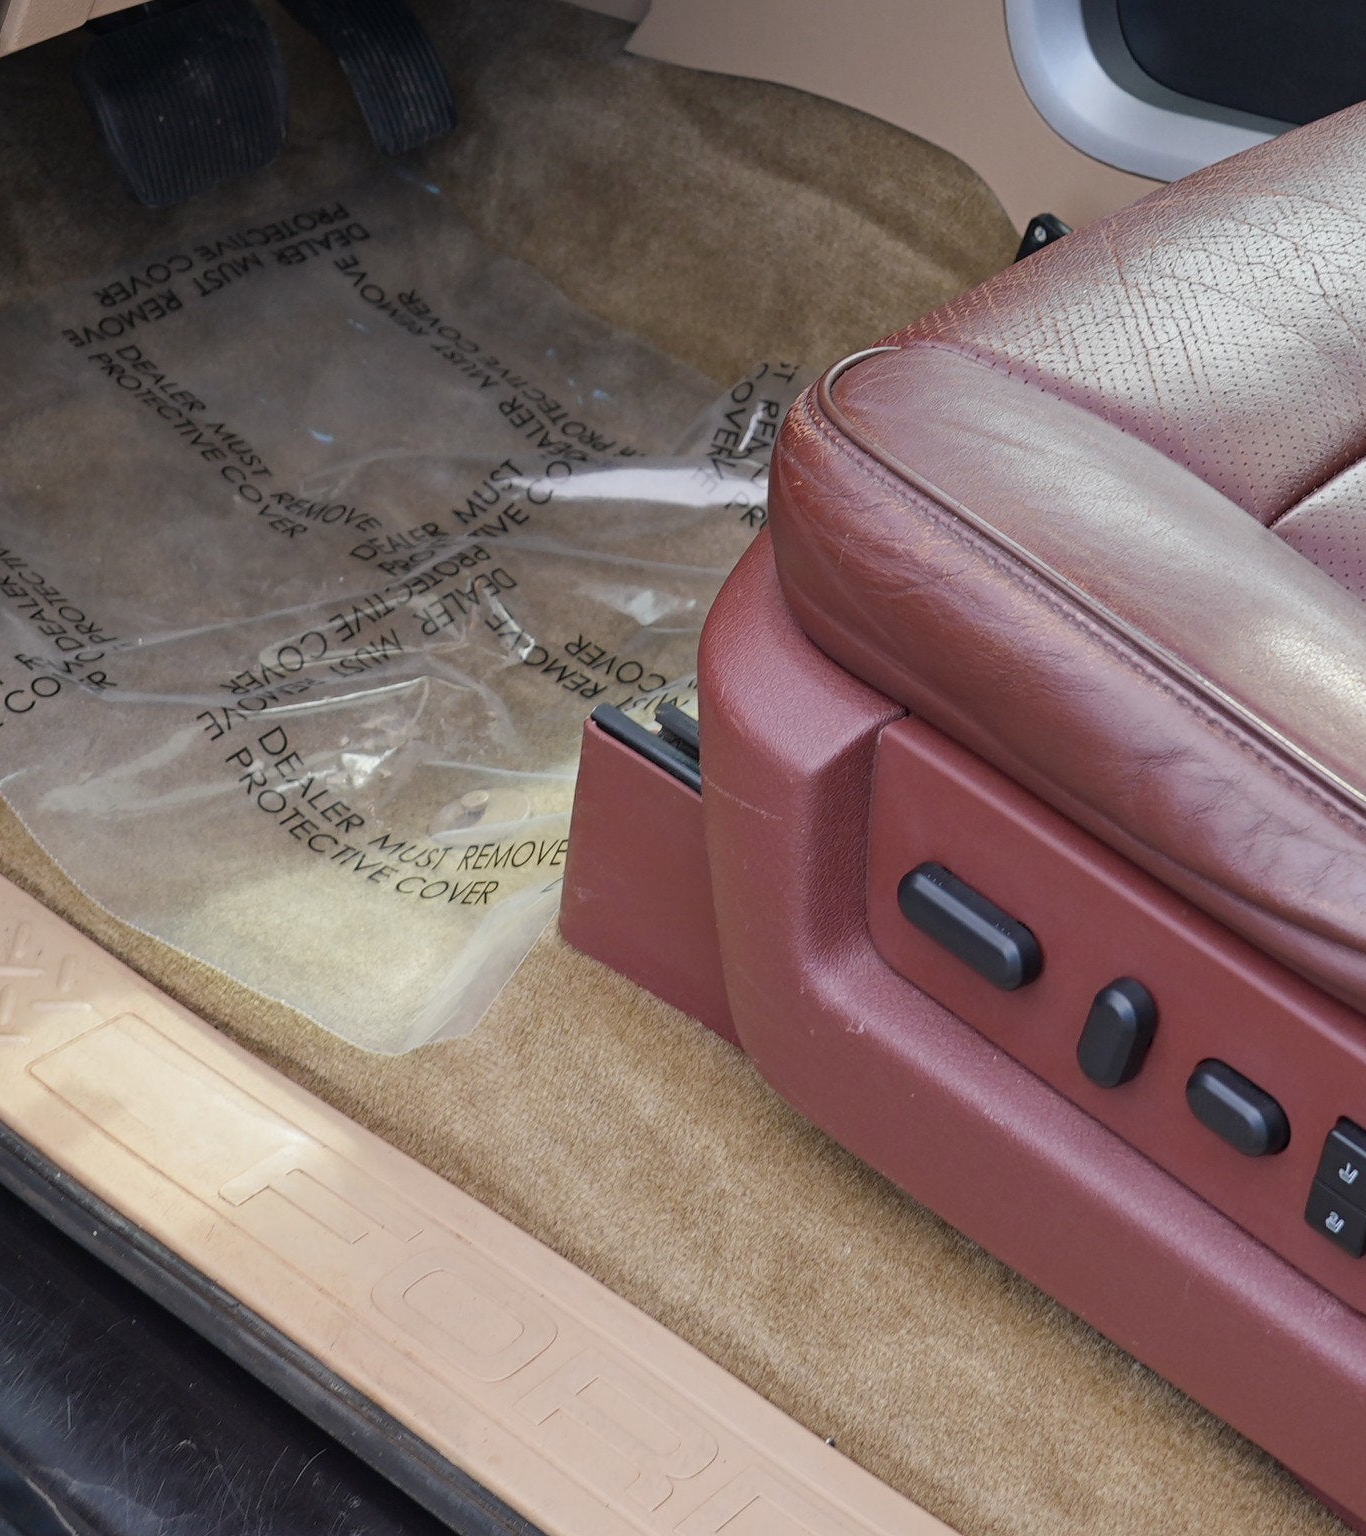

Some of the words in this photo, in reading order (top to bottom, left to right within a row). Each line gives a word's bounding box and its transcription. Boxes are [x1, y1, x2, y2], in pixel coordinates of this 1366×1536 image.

[193, 202, 351, 263] PROTECTIVE
[271, 221, 372, 266] DEALER
[91, 253, 194, 309] COVER
[192, 251, 265, 298] MUST
[61, 288, 183, 348] REMOVE
[397, 288, 480, 354] COVER
[87, 351, 228, 463] PROTECTIVE
[221, 464, 310, 540] COVER
[116, 344, 208, 414] DEALER
[205, 421, 273, 478] MUST
[269, 490, 384, 533] REMOVE
[349, 521, 452, 564] DEALER
[451, 458, 526, 526] MUST
[327, 544, 493, 643] PROTECTIVE
[412, 567, 518, 637] DEALER
[219, 630, 329, 696] COVER
[564, 633, 667, 693] COVER
[225, 746, 400, 885] PROTECTIVE
[394, 874, 501, 906] COVER
[258, 725, 366, 835] DEALER
[367, 831, 449, 871] MUST
[455, 838, 570, 872] REMOVE
